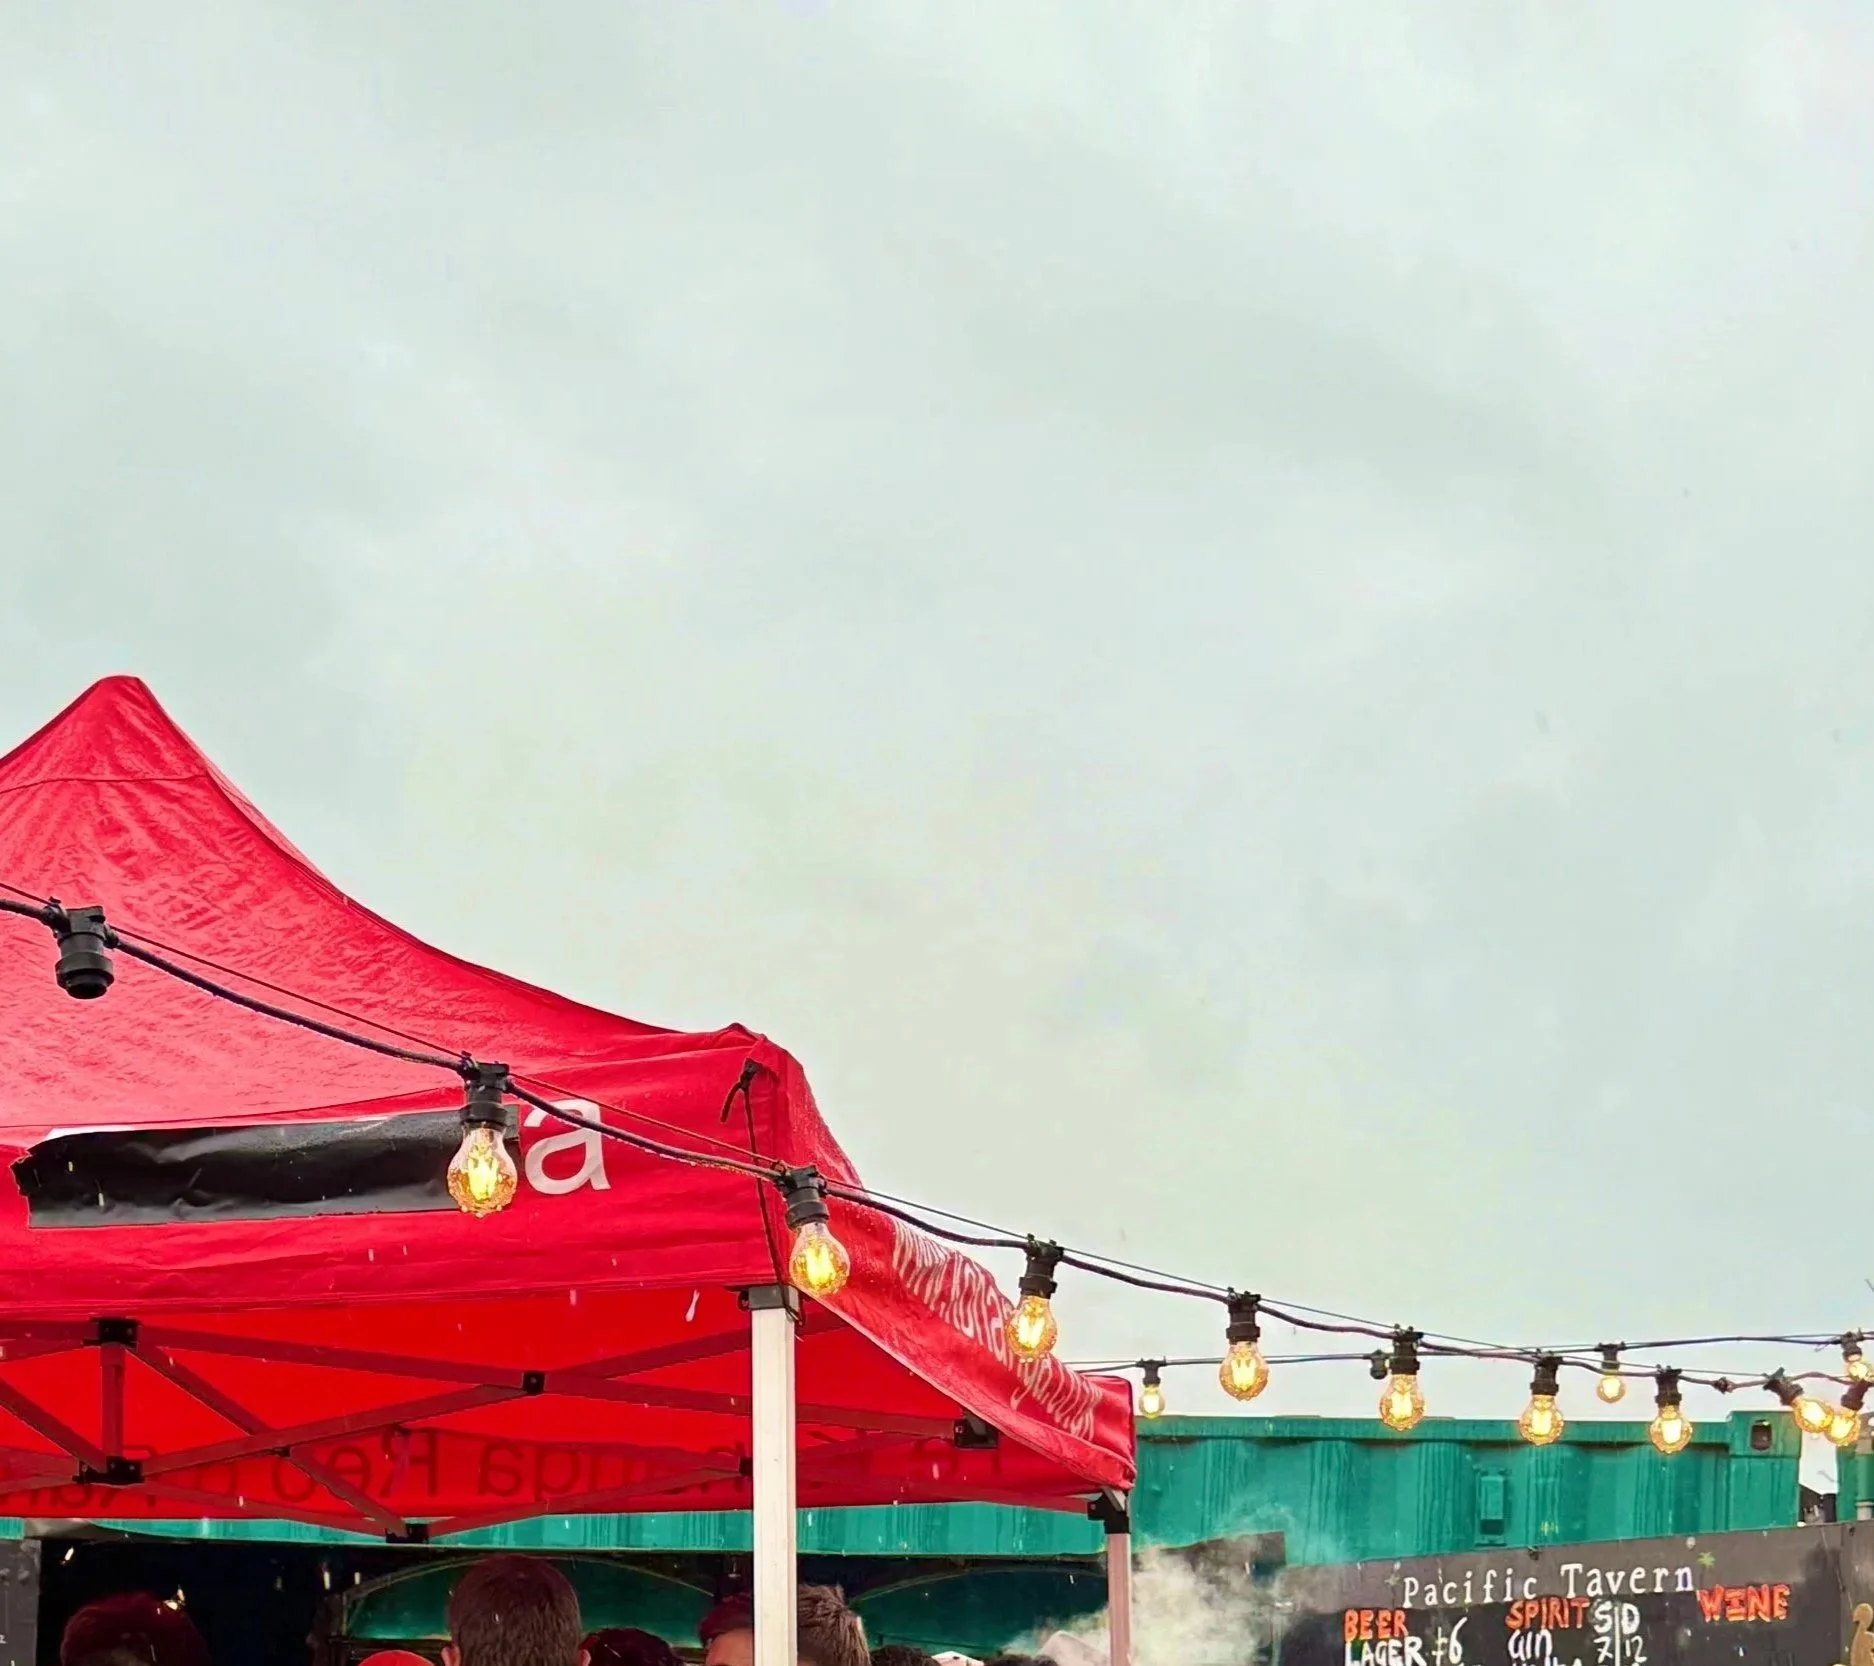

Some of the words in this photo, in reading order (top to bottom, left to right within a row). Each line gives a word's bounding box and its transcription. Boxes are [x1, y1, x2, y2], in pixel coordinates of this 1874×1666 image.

[1403, 1568, 1537, 1608] Pacific
[1560, 1563, 1695, 1597] Tavern
[1505, 1597, 1590, 1630] SPIRIT
[1696, 1584, 1792, 1623] WINE
[1344, 1609, 1409, 1641] BEER
[1594, 1637, 1613, 1663] 7
[1625, 1636, 1647, 1663] 12
